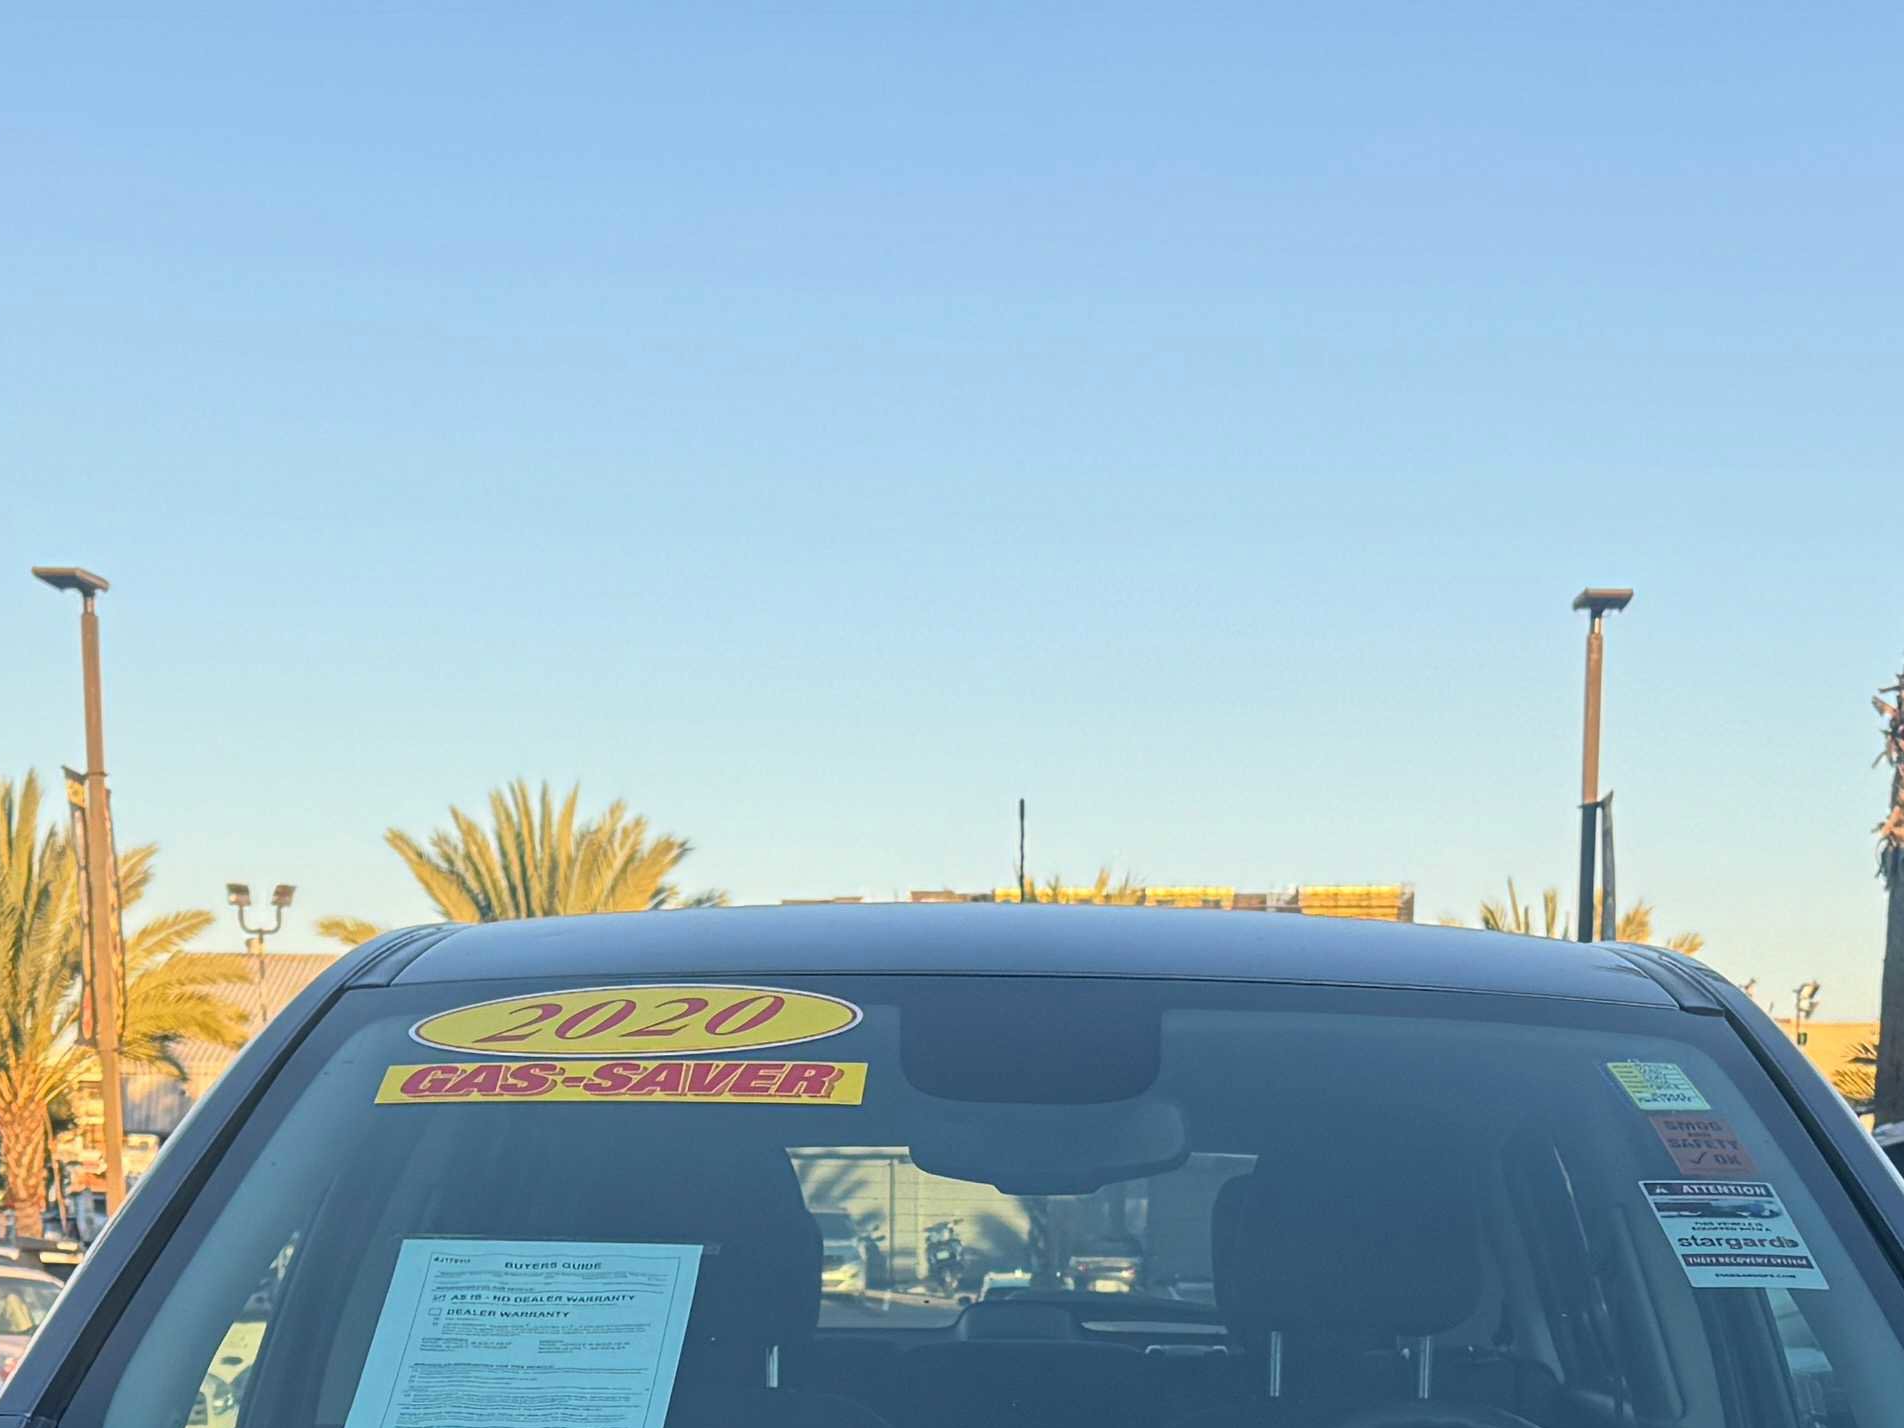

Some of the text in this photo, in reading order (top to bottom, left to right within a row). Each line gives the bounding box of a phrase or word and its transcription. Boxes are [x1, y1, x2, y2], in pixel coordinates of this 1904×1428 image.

[472, 996, 787, 1043] 2020
[399, 1062, 845, 1101] GAS-SAVER
[1667, 1138, 1740, 1151] SAFETY
[1681, 1184, 1767, 1196] ATTENTION
[504, 1261, 603, 1271] BUYERS GUIDE
[514, 1295, 563, 1303] DEALER
[566, 1294, 635, 1303] WARRANTY
[447, 1308, 571, 1319] DEALER WARRANTY
